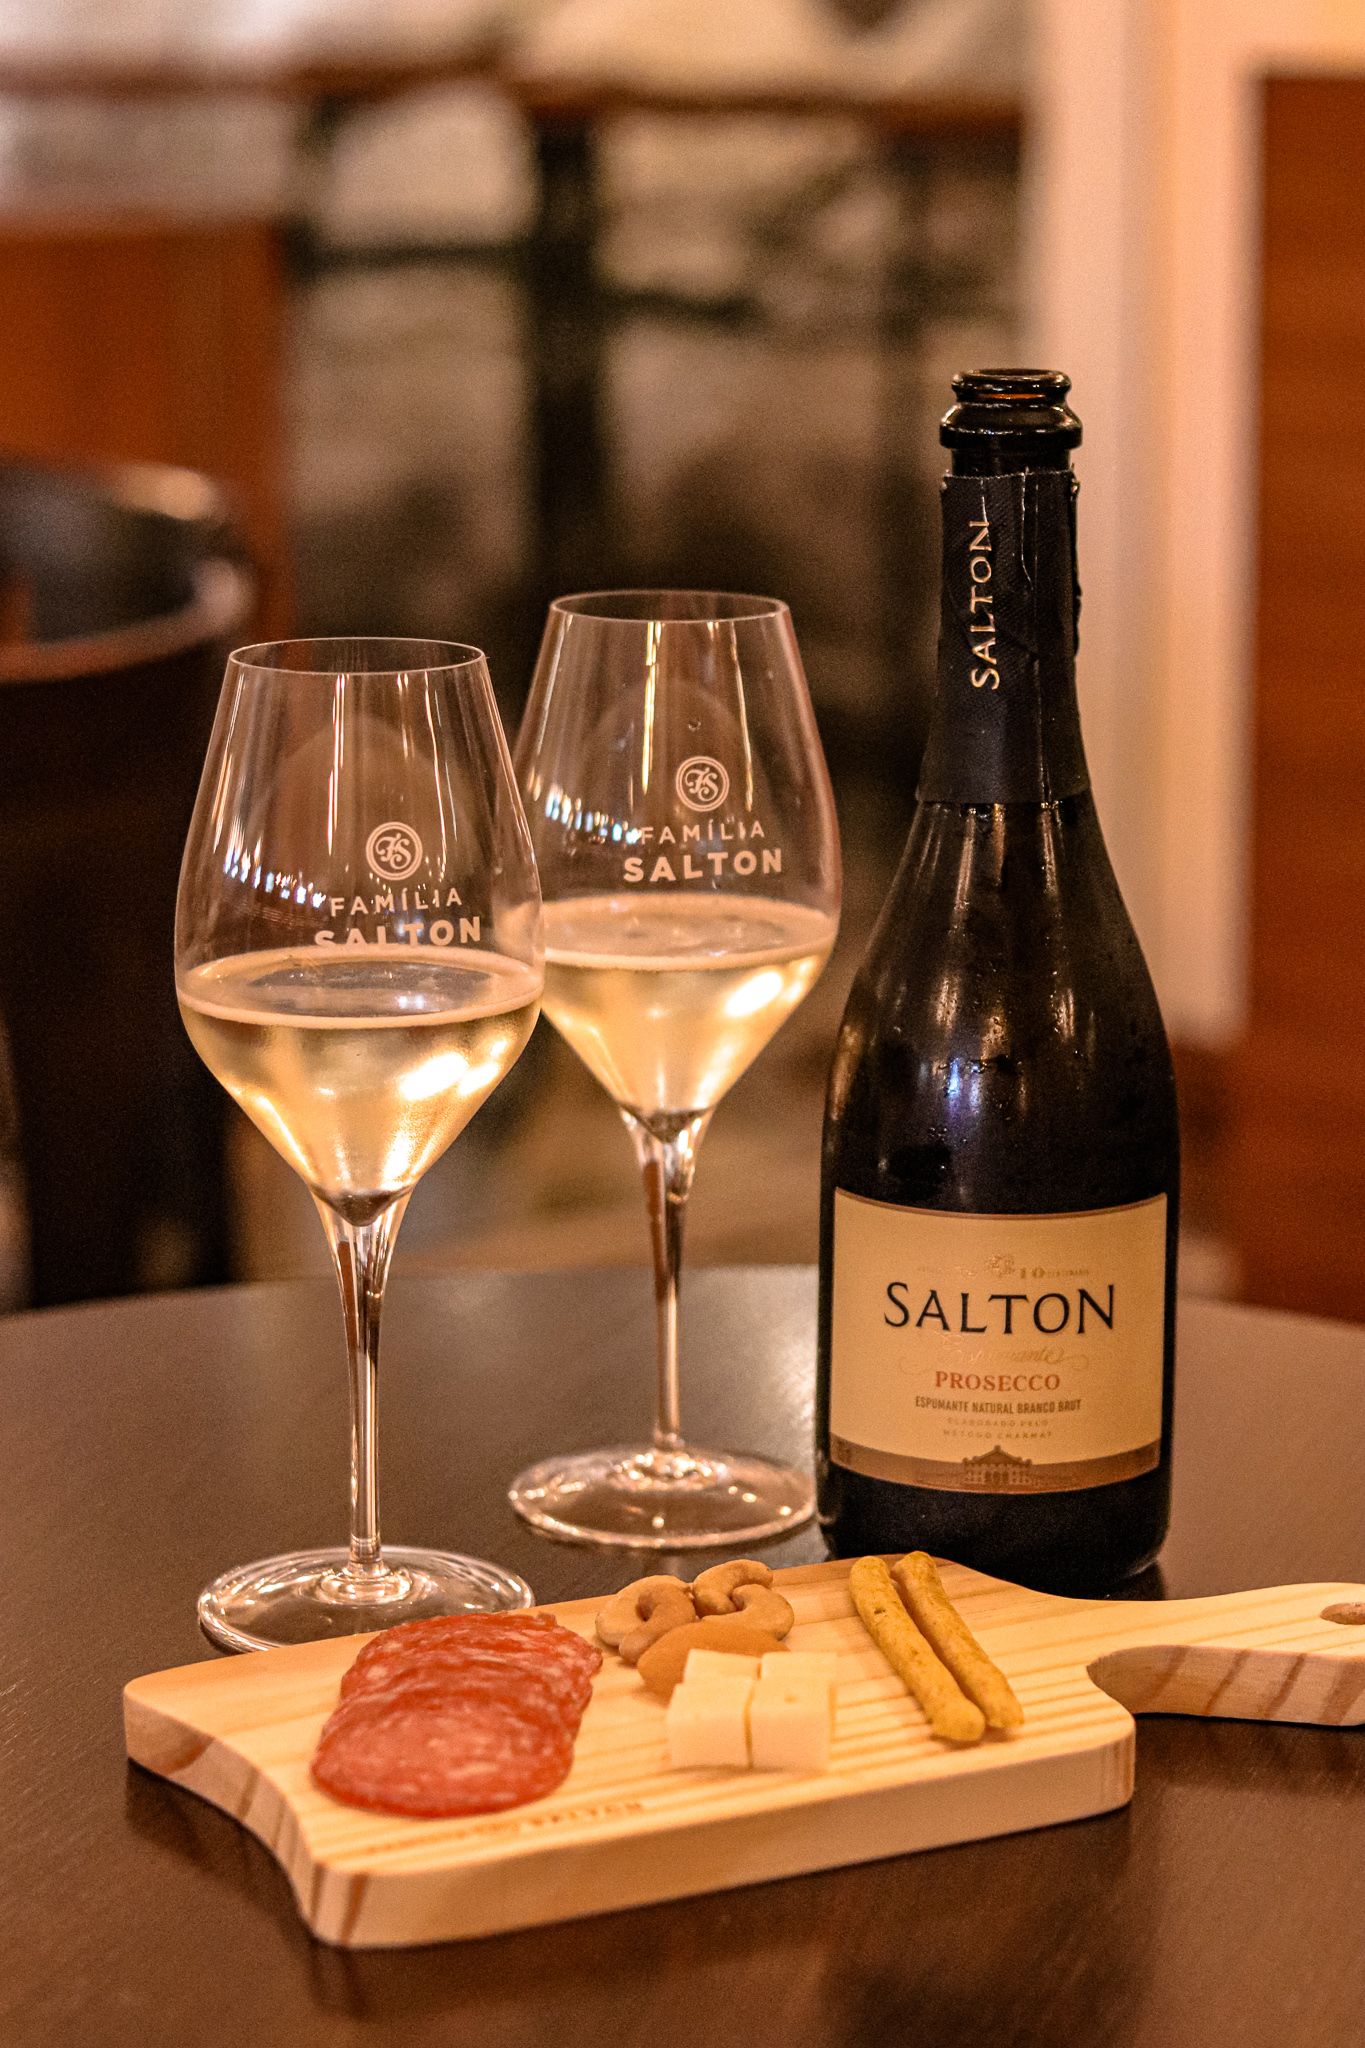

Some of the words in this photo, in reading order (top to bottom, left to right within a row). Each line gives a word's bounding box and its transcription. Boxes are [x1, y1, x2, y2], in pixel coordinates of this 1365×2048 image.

[969, 521, 1000, 690] SALTON
[640, 819, 765, 845] FAMÍLIA
[623, 848, 782, 883] SALTON
[330, 887, 462, 917] FAMÍLIA
[884, 1281, 1114, 1335] SALTON
[935, 1370, 1061, 1392] PROSECCO
[915, 1395, 968, 1412] ESPUMANTE
[972, 1401, 1014, 1414] NATURAL
[1017, 1401, 1055, 1414] BRANCO
[1058, 1398, 1082, 1412] BRUT
